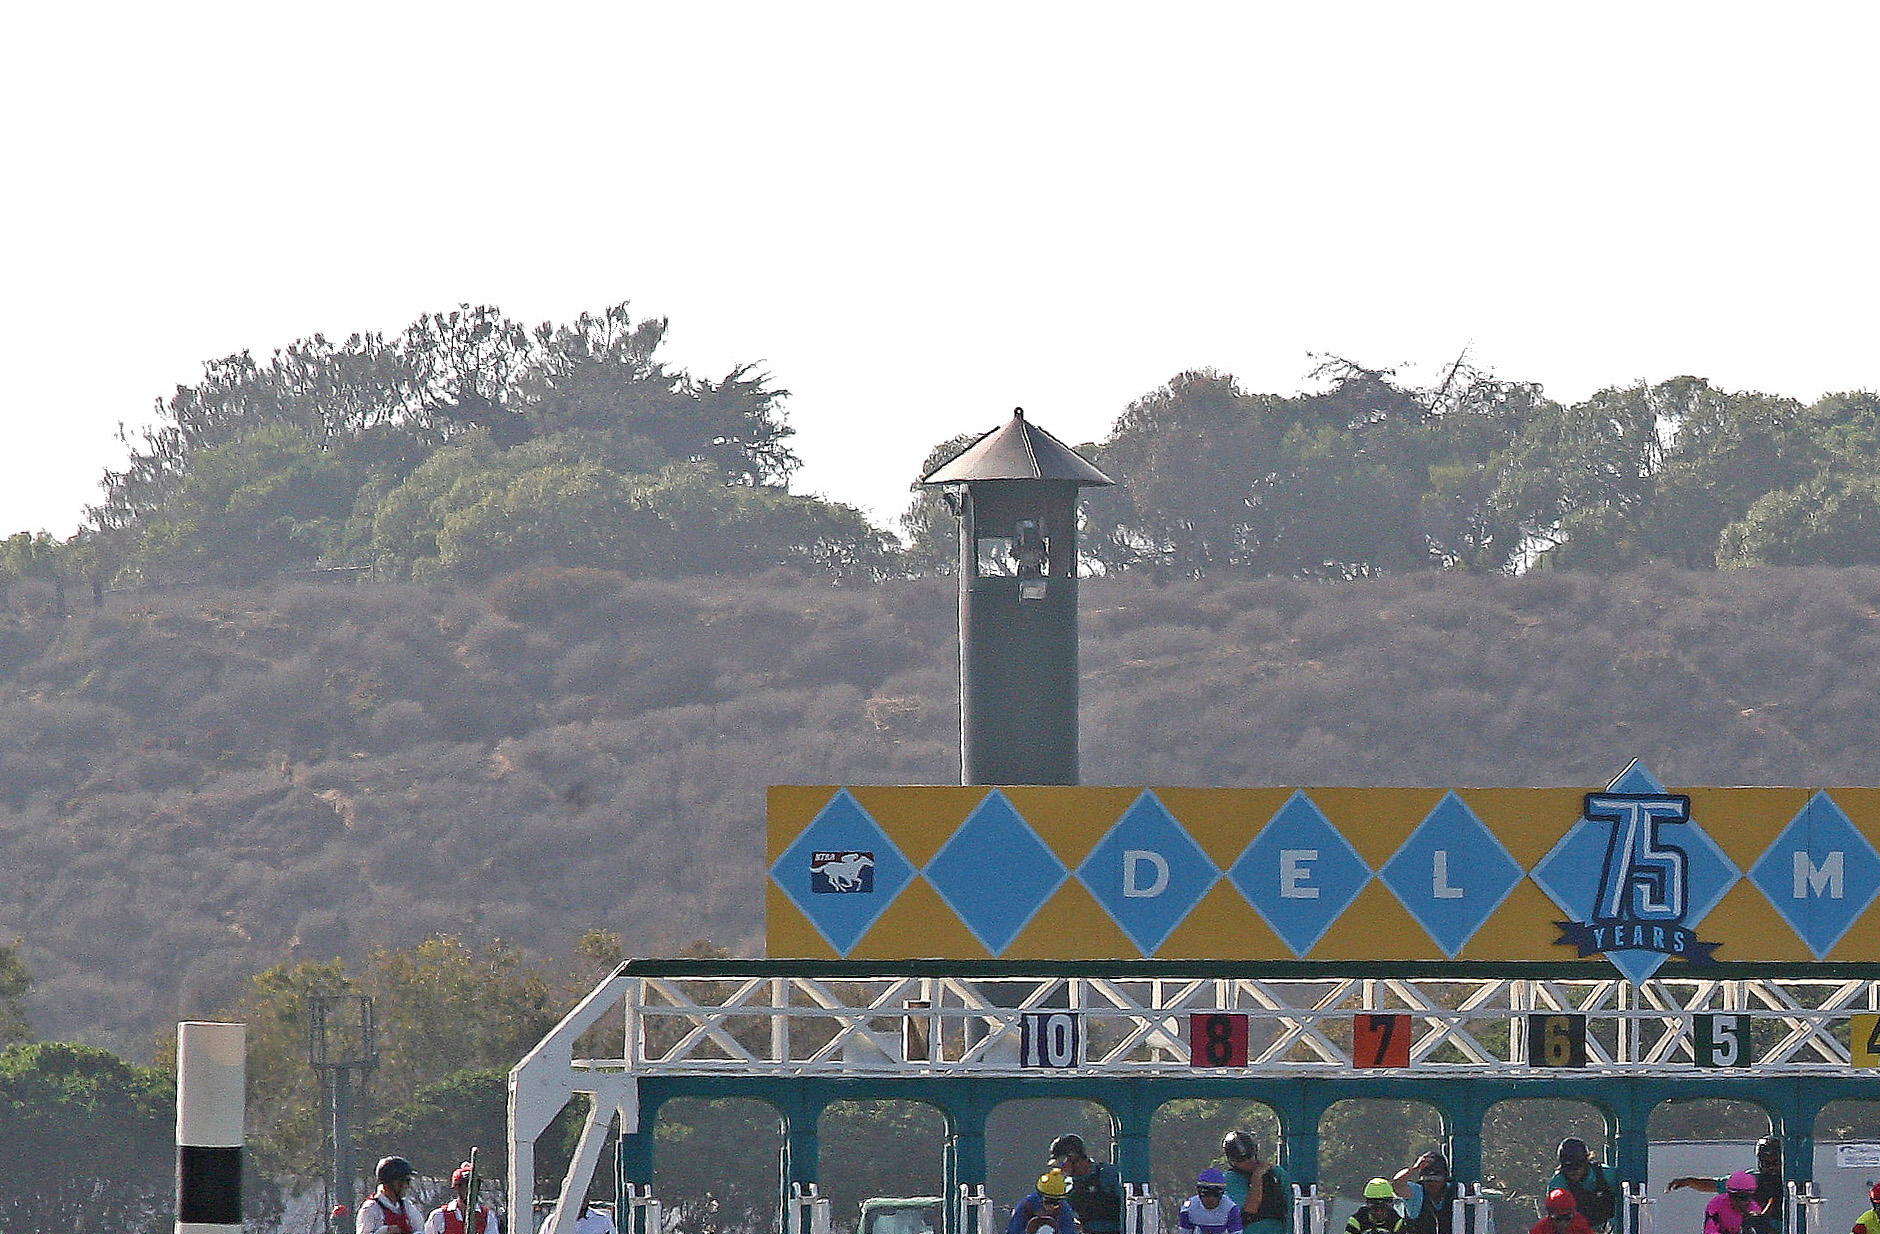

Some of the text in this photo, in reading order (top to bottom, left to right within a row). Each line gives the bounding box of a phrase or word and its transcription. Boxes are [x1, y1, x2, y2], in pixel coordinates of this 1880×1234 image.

[1123, 849, 1464, 899] DEL
[1584, 793, 1690, 921] 75
[1593, 924, 1686, 952] YEARS
[1027, 1014, 1073, 1067] 10
[1206, 1014, 1233, 1066] 8
[1369, 1015, 1396, 1065] 7
[1544, 1015, 1571, 1066] 6
[1712, 1015, 1738, 1067] 5
